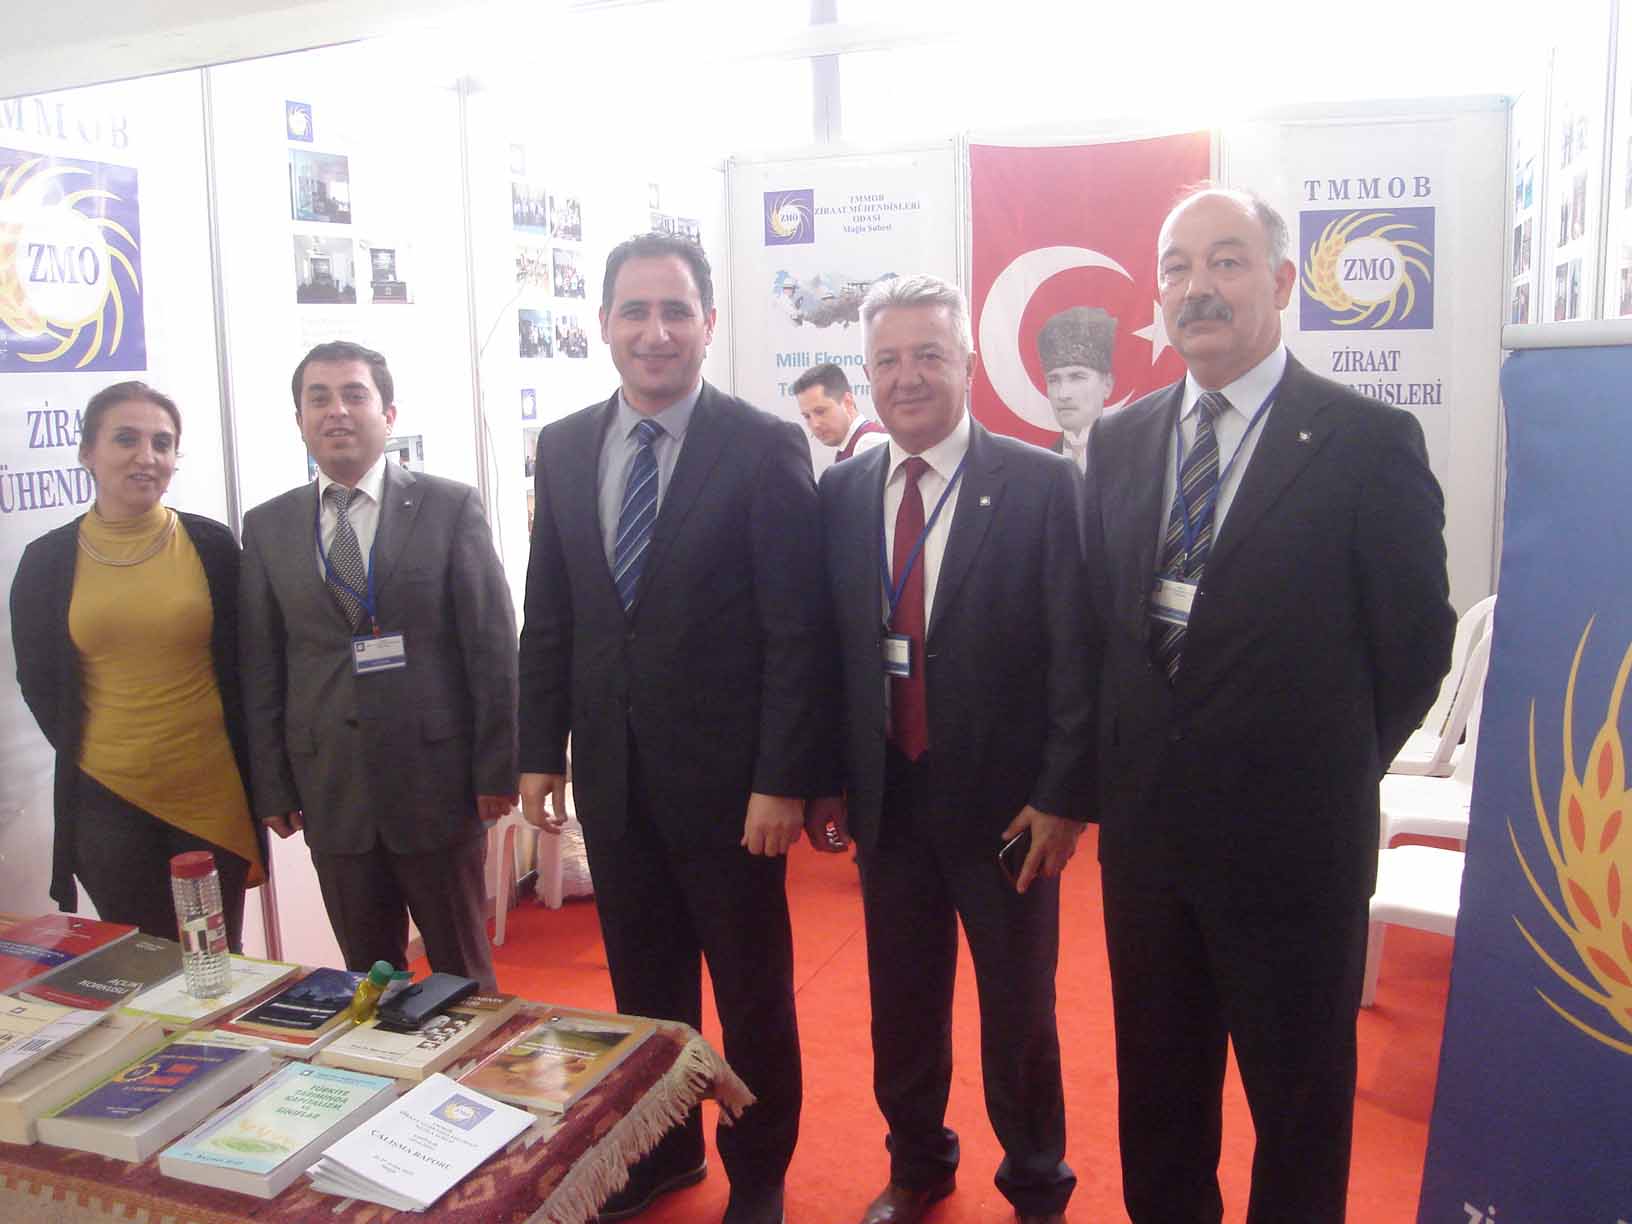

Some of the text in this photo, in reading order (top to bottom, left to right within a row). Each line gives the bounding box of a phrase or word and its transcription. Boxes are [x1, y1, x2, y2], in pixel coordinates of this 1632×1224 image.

[1304, 176, 1432, 200] TMMOB
[780, 214, 799, 224] ZMO
[28, 242, 100, 286] ZMO
[1343, 257, 1395, 282] ZMO
[776, 351, 810, 369] Milli
[1332, 346, 1400, 373] ZİRAAT
